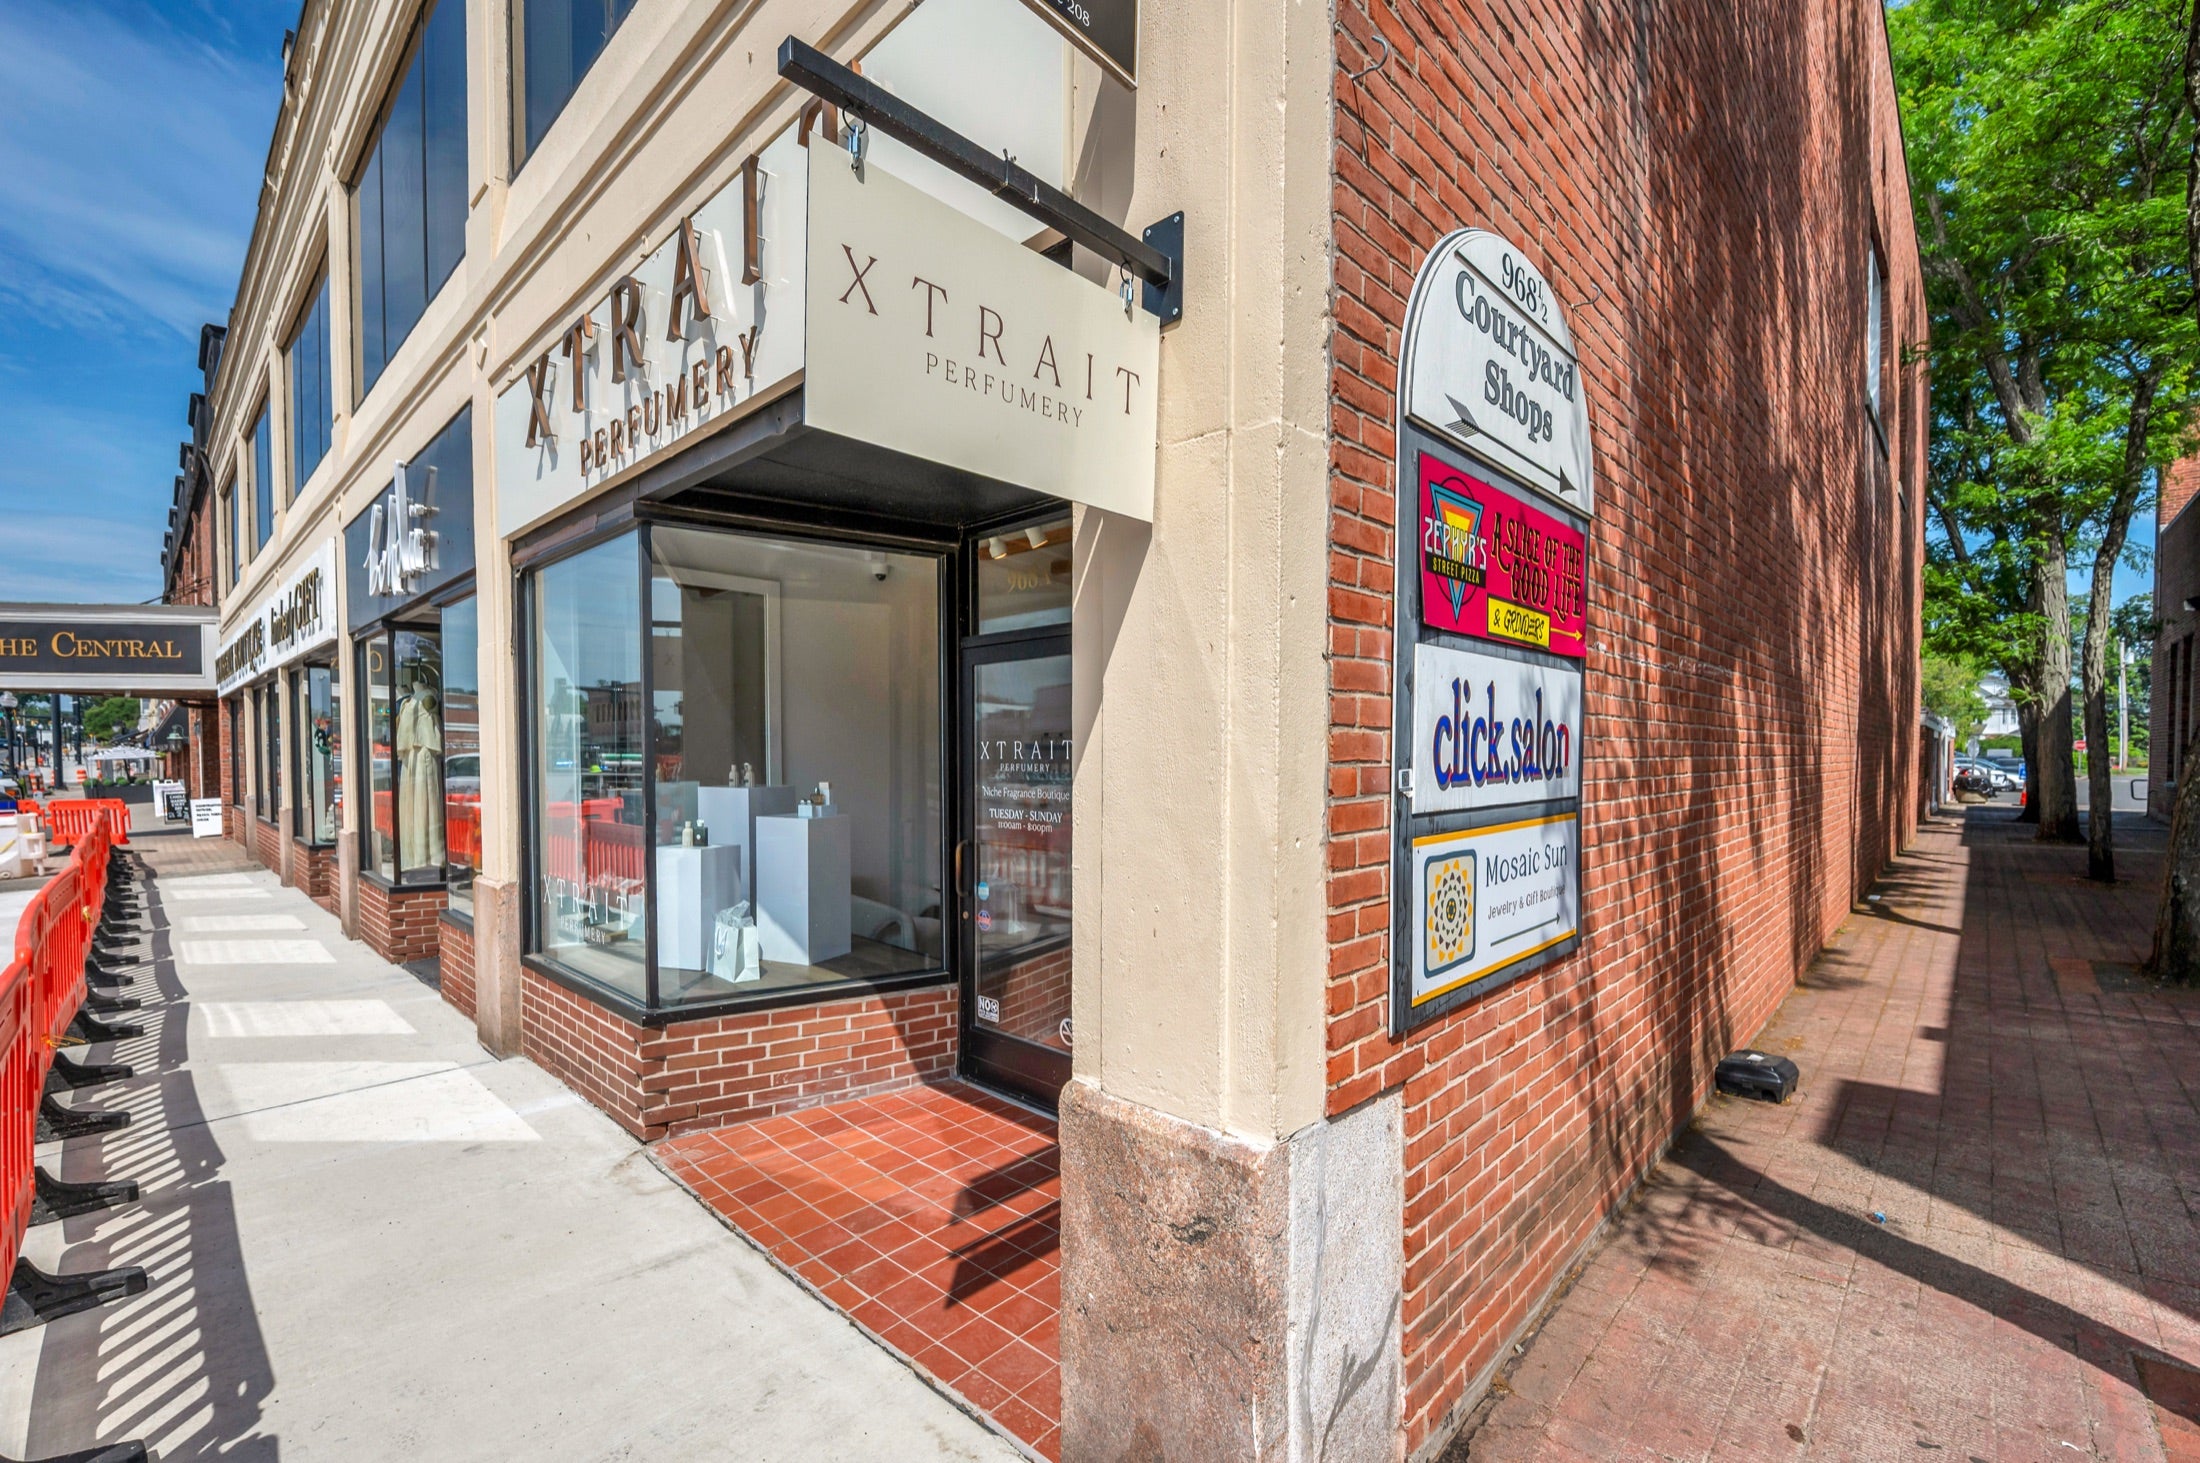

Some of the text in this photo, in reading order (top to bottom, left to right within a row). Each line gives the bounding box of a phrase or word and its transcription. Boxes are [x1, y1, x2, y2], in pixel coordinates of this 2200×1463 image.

[1066, 0, 1090, 27] 208
[838, 243, 1141, 415] XTRAIT
[1455, 270, 1575, 403] Courtyard
[580, 326, 758, 477] PERFUMERY
[926, 352, 1083, 428] PERFUMERY
[1484, 359, 1553, 443] Shops
[1424, 516, 1487, 571] ZEPHYR'S
[1490, 512, 1582, 581] A SLICE OF THE
[1432, 556, 1480, 585] STREET PIZZA
[294, 567, 319, 630] GIFT
[1510, 559, 1581, 623] GOOD LIFE
[1493, 608, 1545, 641] & GRINDERS
[0, 638, 38, 657] HE
[980, 740, 1072, 760] XTRAIT
[1000, 763, 1050, 773] PERFUMERY
[982, 785, 1070, 802] Niche Fragrance Boutique
[989, 808, 1024, 820] TUESDAY
[1029, 810, 1063, 823] SUNDAY
[1027, 822, 1053, 835] 8:00pm
[1486, 843, 1567, 887] Mosaic Sun
[543, 874, 628, 930] XTRAIT
[1488, 884, 1566, 920] Jewelry & Gift Boutique
[560, 916, 606, 945] PERFUMERY
